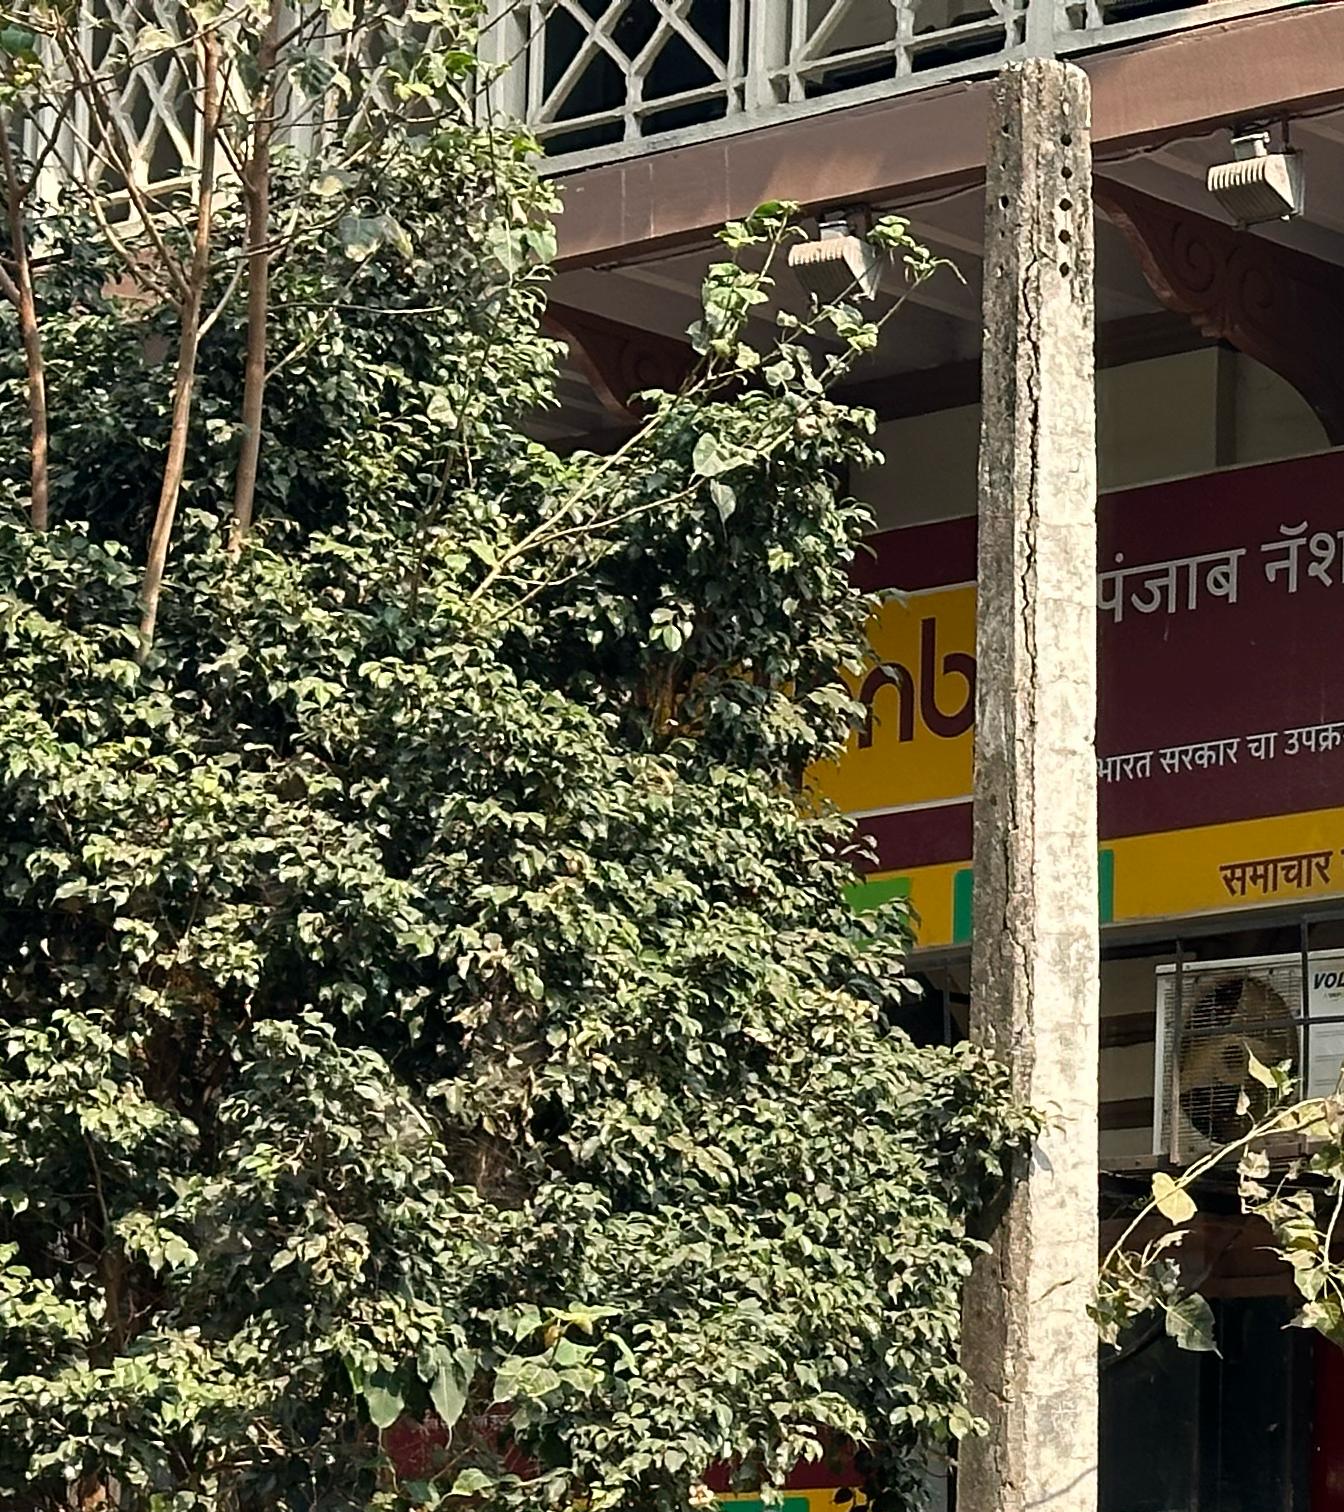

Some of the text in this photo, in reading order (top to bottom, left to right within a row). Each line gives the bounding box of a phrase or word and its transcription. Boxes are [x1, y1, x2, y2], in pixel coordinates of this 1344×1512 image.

[838, 617, 977, 750] nb
[1159, 737, 1239, 777] सरकार
[1246, 731, 1278, 765] चा
[1219, 846, 1332, 897] समाचार
